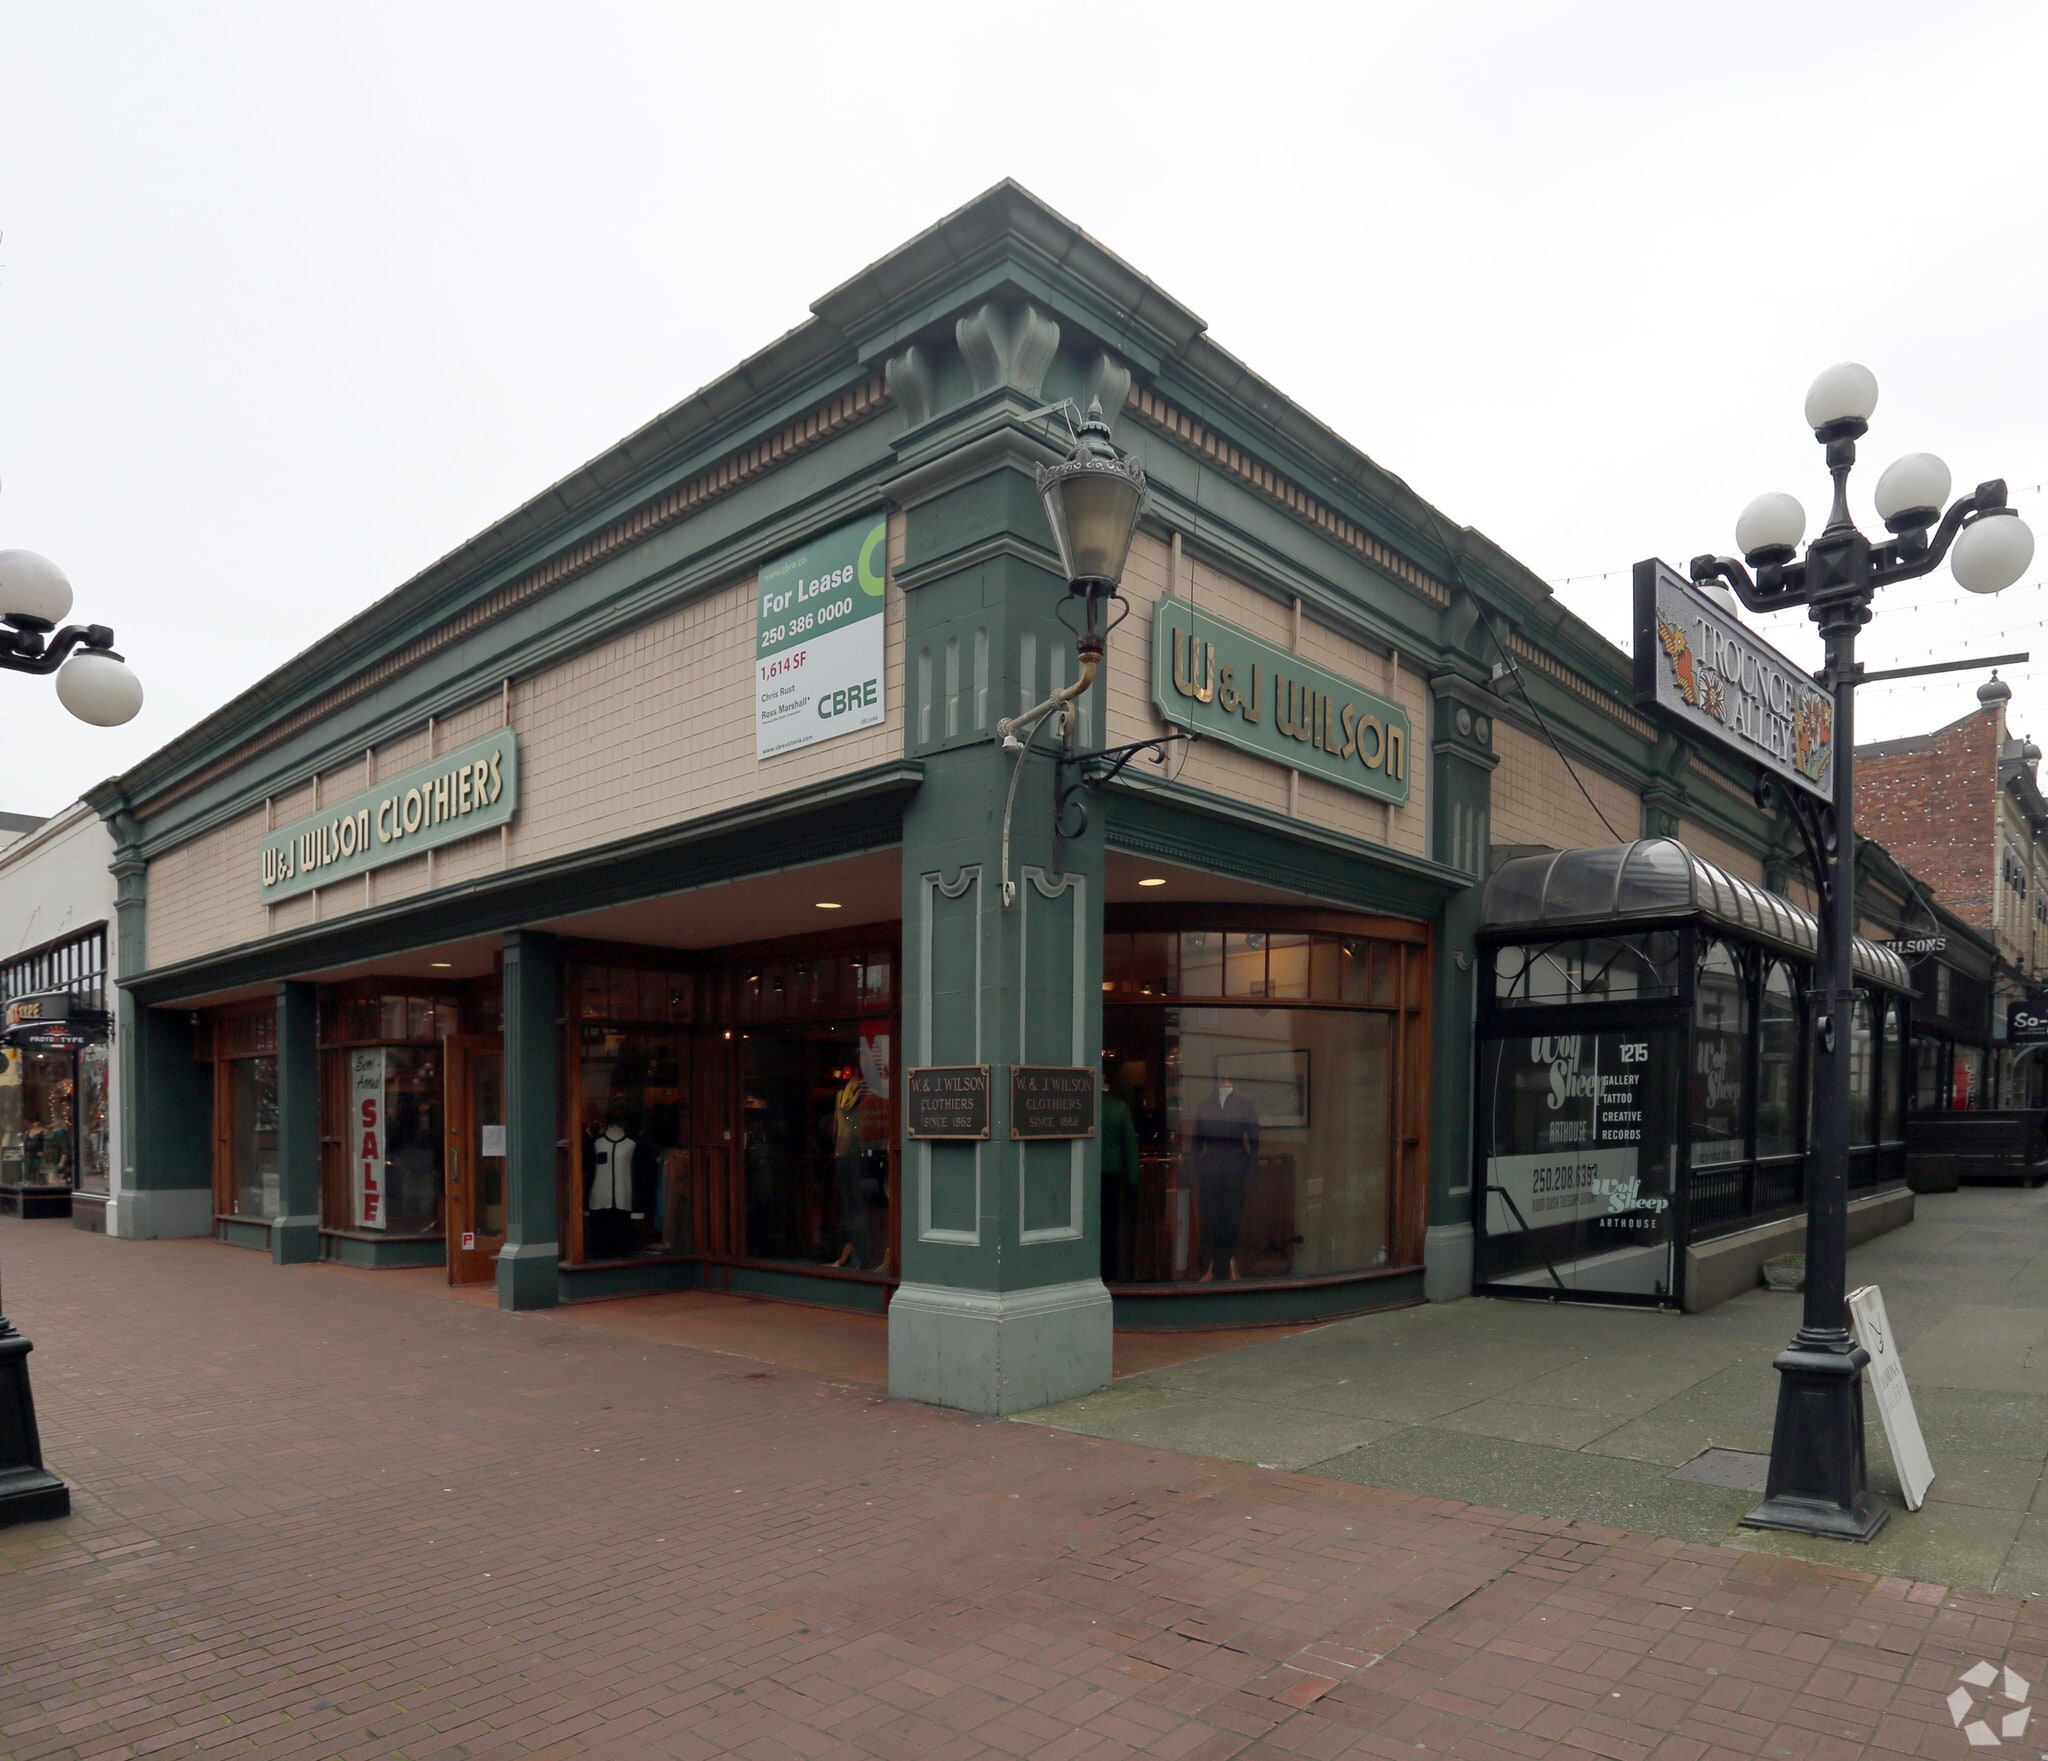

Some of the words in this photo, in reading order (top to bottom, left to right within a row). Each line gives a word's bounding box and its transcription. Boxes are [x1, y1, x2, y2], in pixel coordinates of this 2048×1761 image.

[762, 590, 793, 618] For
[798, 564, 854, 602] Lease
[761, 624, 786, 648] 250
[789, 612, 814, 637] 386
[817, 597, 853, 625] 0000
[760, 657, 791, 682] 1,614
[793, 650, 807, 669] SF
[1695, 615, 1795, 723] TROUNCE
[761, 690, 778, 703] Chris
[780, 684, 796, 697] Rust
[817, 678, 878, 720] CBRE
[761, 708, 777, 720] Ross
[1275, 673, 1405, 781] WILSON
[1728, 690, 1793, 763] ALLEY
[300, 807, 371, 873] WILSON
[377, 749, 503, 844] CLOTHIERS
[1619, 1043, 1648, 1063] 1215
[944, 1076, 986, 1092] WILSON
[1052, 1077, 1092, 1093] WILSON
[1547, 1059, 1606, 1109] Sheep
[1602, 1074, 1640, 1086] GALLERY
[921, 1098, 974, 1111] CLOTHIERS
[1026, 1098, 1082, 1111] CLOTHIERS
[1603, 1093, 1633, 1104] TATTOO
[924, 1116, 948, 1128] SINCE
[952, 1116, 972, 1128] 1862
[1028, 1116, 1054, 1128] SINCE
[1060, 1116, 1079, 1128] 1862
[1602, 1111, 1643, 1122] CREATIVE
[1549, 1120, 1587, 1143] ARTHOUSE
[1602, 1129, 1641, 1140] RECORDS
[360, 1098, 380, 1222] SALE
[1591, 1176, 1642, 1199] Wolf
[1608, 1192, 1669, 1214] Sheep
[1599, 1218, 1657, 1229] ARTHOUSE
